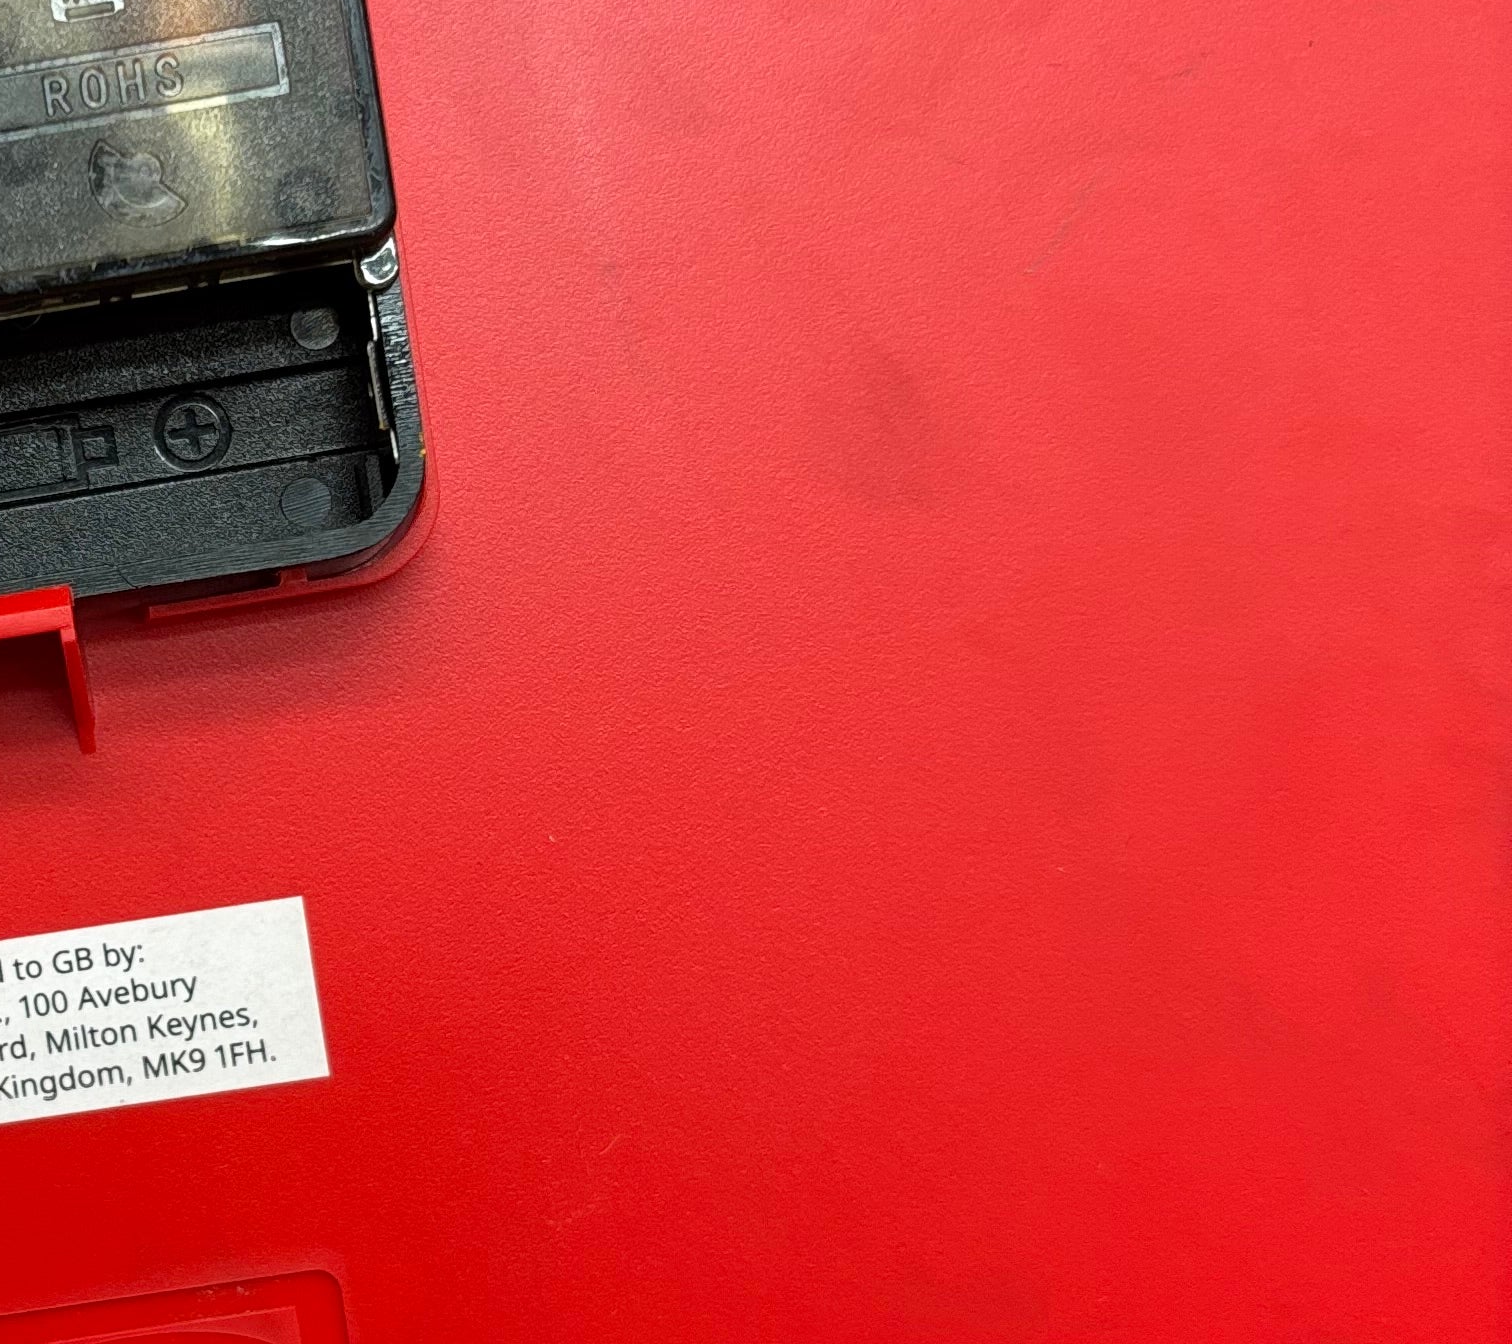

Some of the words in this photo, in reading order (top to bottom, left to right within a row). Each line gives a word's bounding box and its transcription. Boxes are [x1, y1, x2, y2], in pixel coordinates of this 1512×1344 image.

[42, 54, 184, 116] ROHS
[14, 960, 43, 981] to
[52, 947, 93, 974] GB
[102, 942, 145, 971] by:
[19, 990, 68, 1019] 100
[78, 976, 198, 1010] Avebury
[45, 1019, 138, 1056] Milton
[147, 1006, 259, 1041] Keynes,
[142, 1048, 206, 1079] MK9
[215, 1040, 277, 1069] 1FH.
